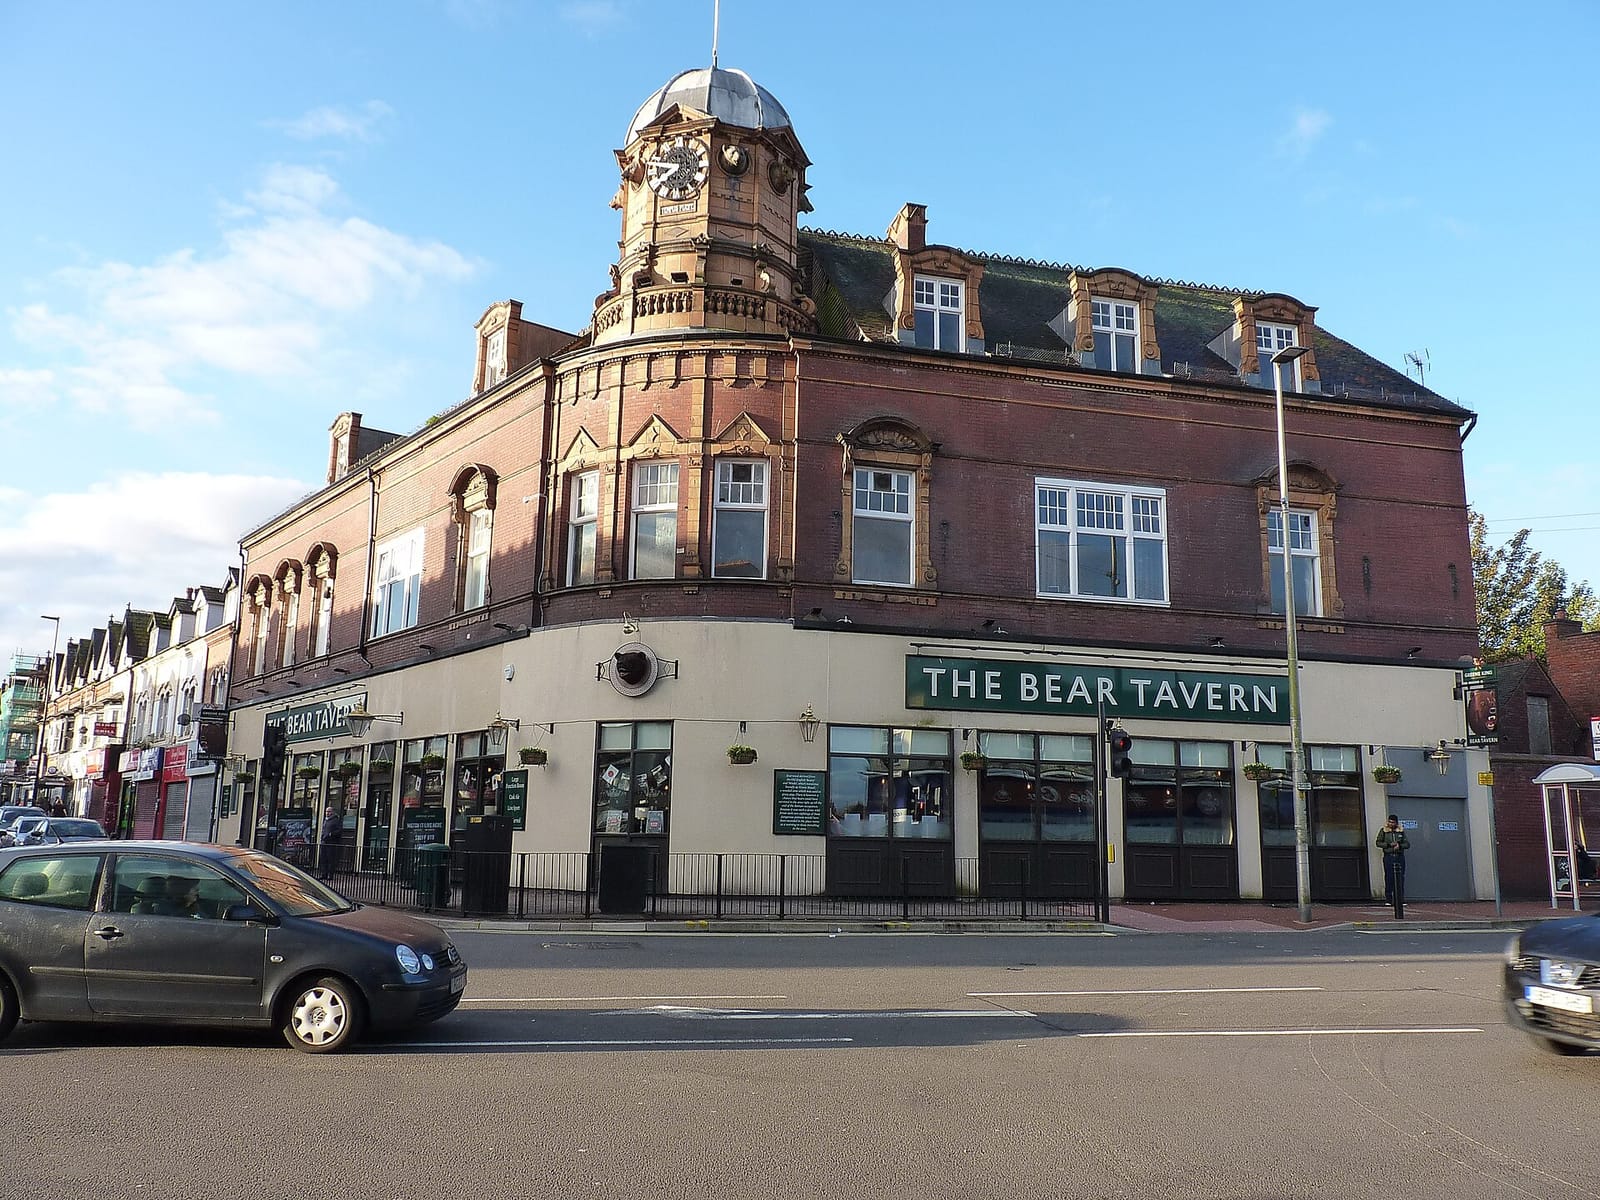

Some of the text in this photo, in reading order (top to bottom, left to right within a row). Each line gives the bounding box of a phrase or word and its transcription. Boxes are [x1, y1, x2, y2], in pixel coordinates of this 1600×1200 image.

[923, 667, 1277, 713] THE BEAR TAVERN
[288, 712, 313, 735] BEAR
